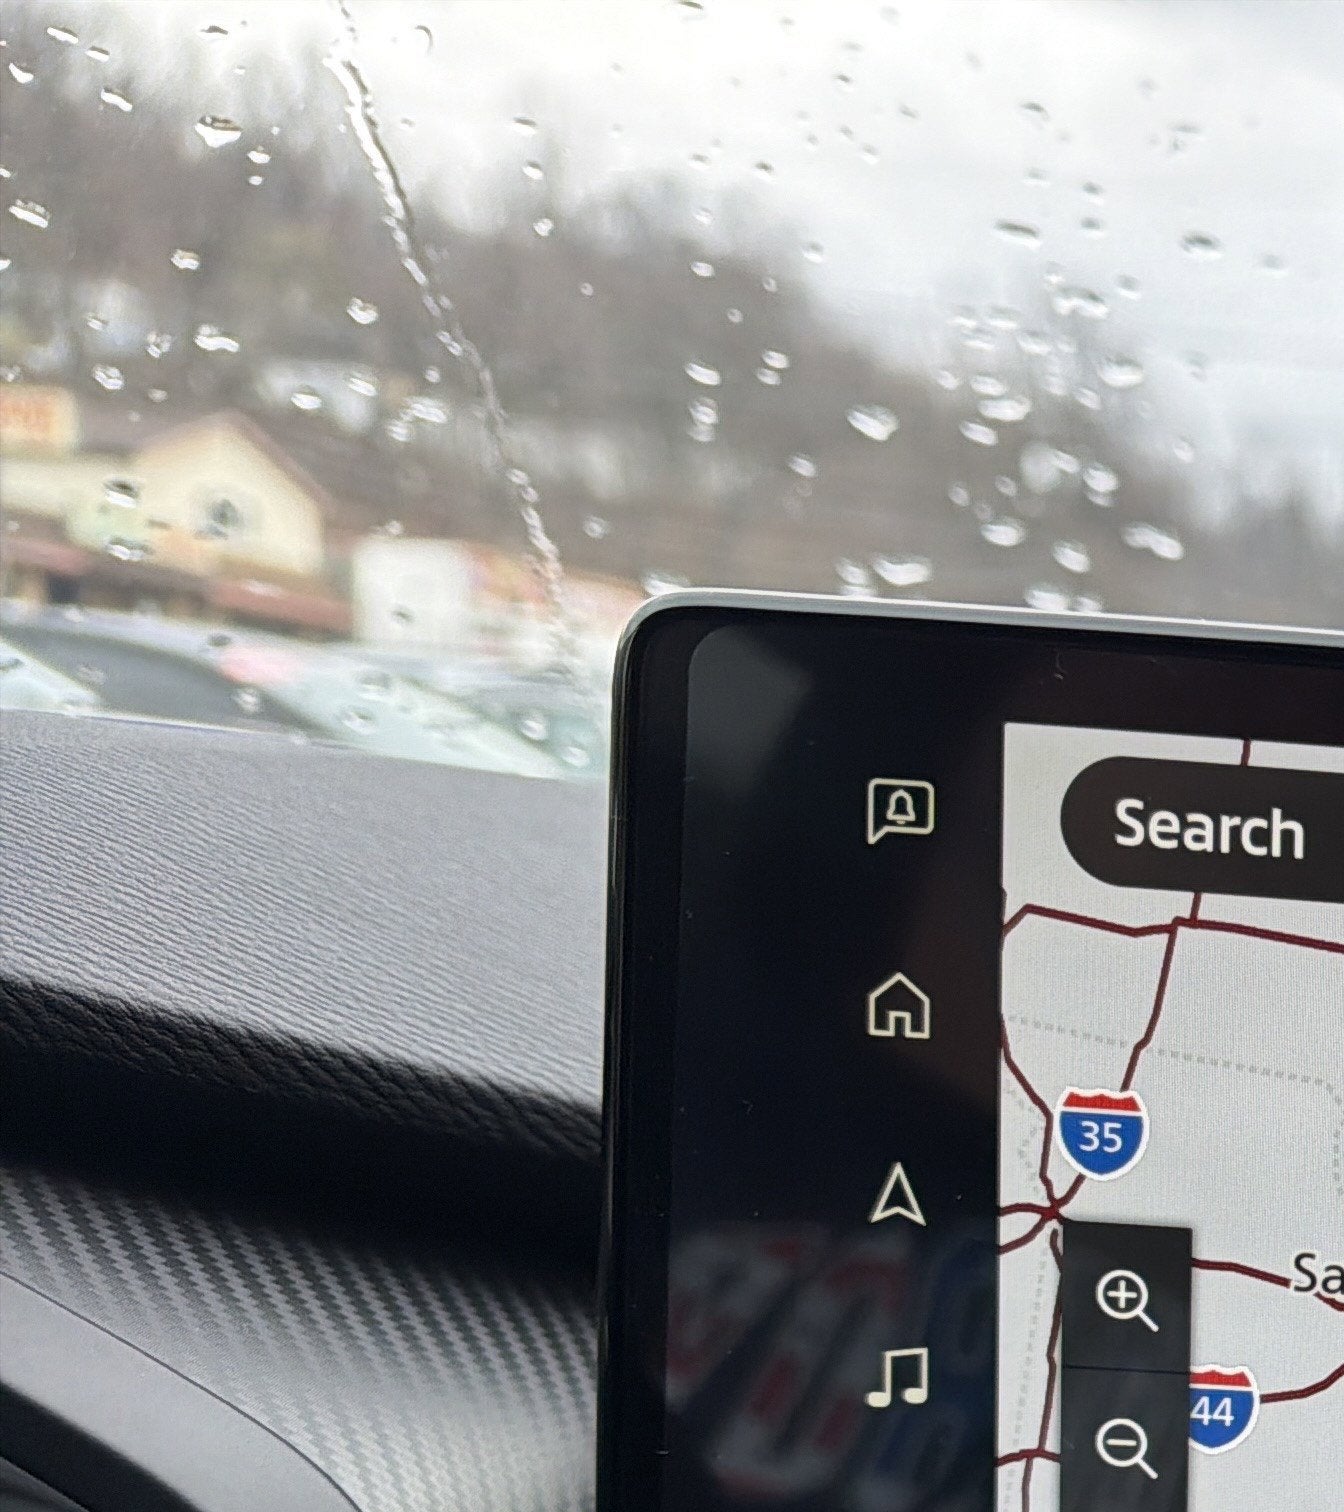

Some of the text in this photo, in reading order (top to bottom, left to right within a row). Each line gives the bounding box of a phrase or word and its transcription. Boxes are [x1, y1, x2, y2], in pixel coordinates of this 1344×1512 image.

[1114, 798, 1305, 860] Search
[1078, 1121, 1123, 1154] 35
[1191, 1396, 1235, 1427] 44
